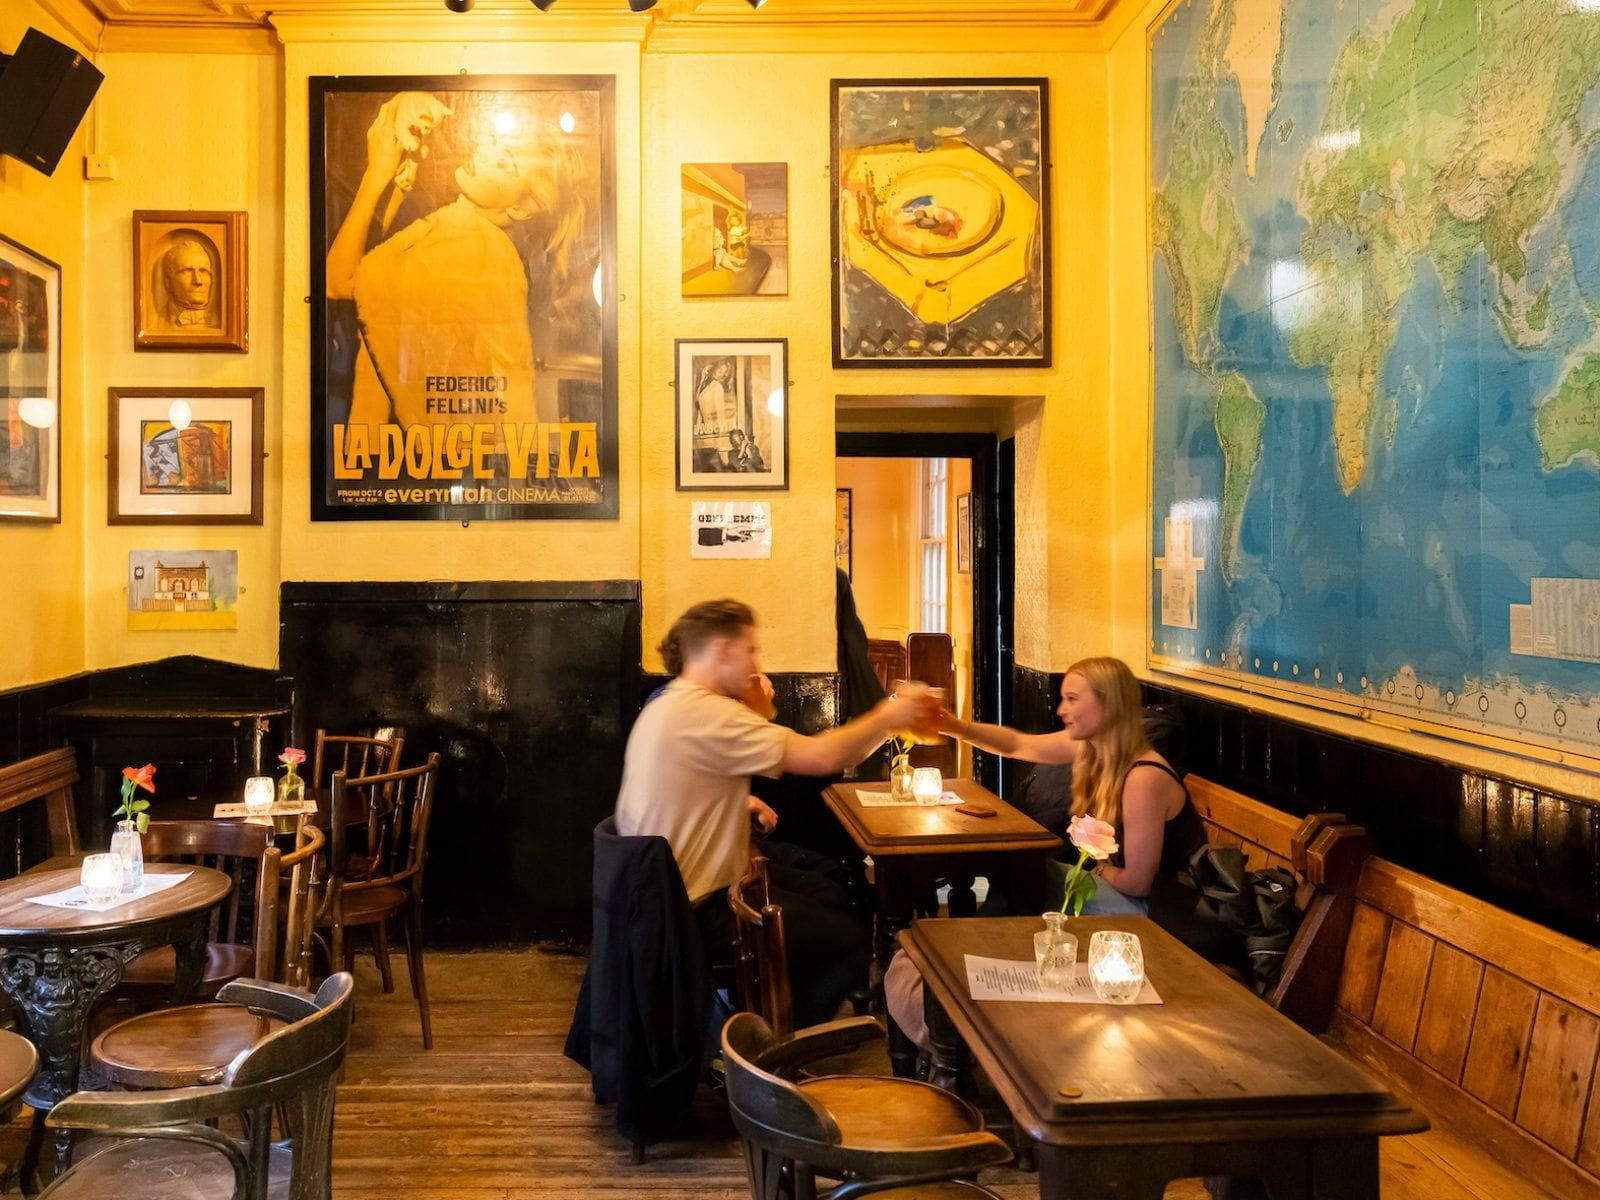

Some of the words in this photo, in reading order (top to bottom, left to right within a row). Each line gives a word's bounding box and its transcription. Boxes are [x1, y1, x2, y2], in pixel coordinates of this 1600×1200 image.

[426, 377, 507, 391] FEDERICO
[426, 398, 508, 413] FELLINI's
[333, 424, 372, 479] LA
[379, 423, 495, 480] DOLCE
[501, 423, 600, 479] VITA
[496, 487, 561, 502] CINEMA
